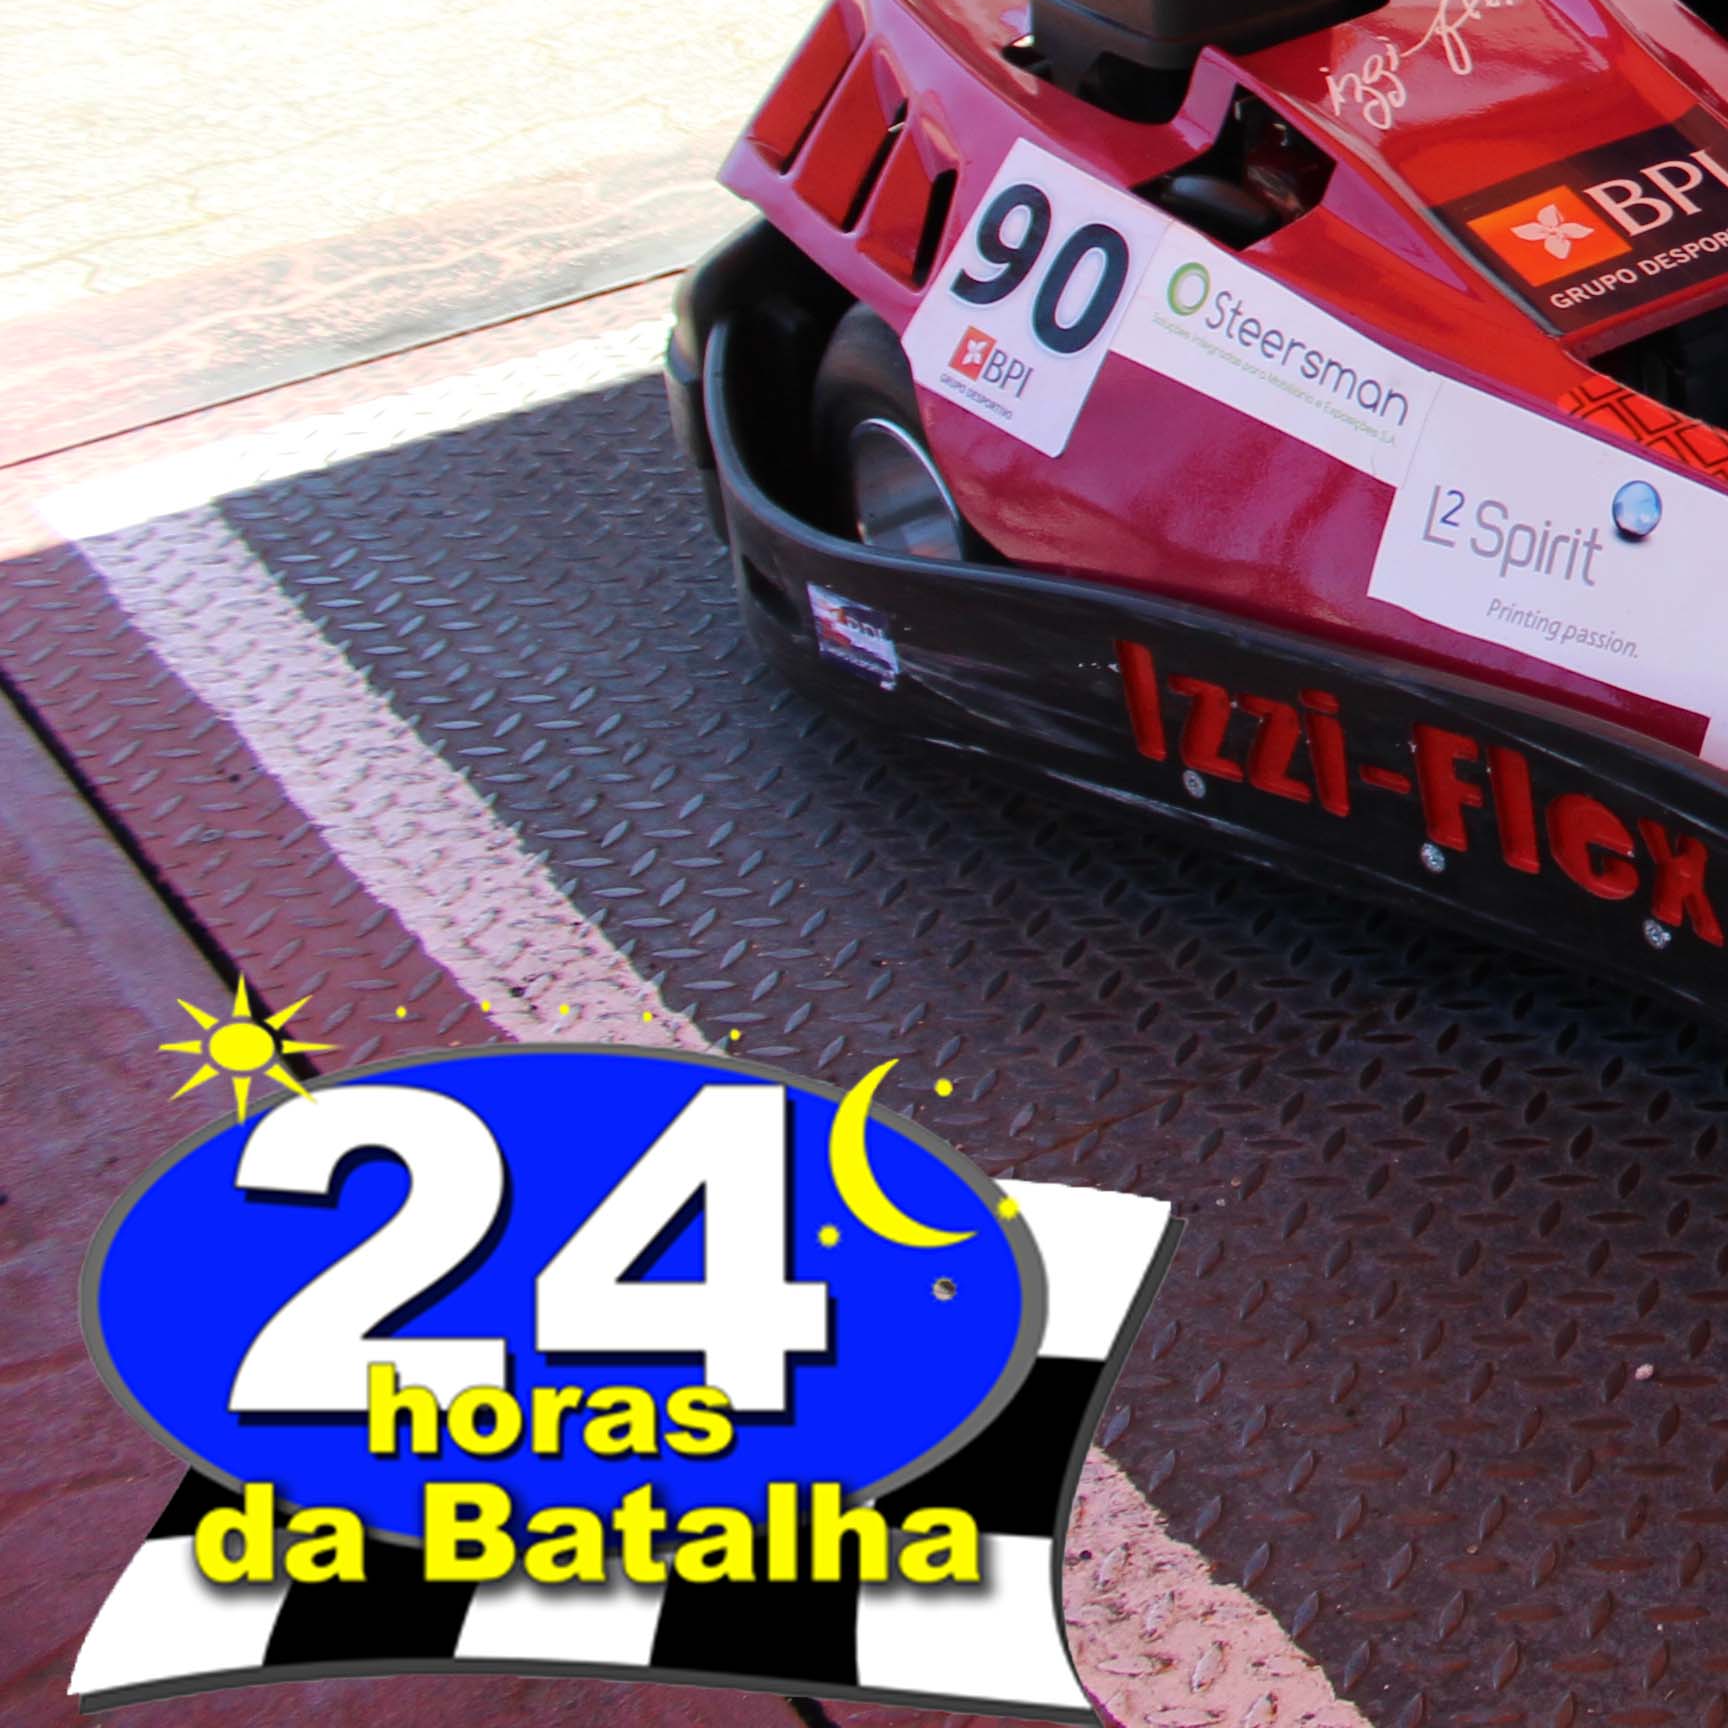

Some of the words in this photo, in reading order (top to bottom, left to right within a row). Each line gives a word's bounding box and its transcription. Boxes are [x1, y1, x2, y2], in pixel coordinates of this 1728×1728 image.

[949, 183, 1130, 354] 90
[1549, 266, 1638, 310] GRUPO
[983, 348, 1034, 399] BPI
[1205, 290, 1409, 427] Steersman
[1469, 498, 1604, 588] Spirit
[1485, 597, 1562, 642] Printing
[1559, 623, 1640, 660] passion.
[1111, 638, 1725, 948] Izzi-Flex
